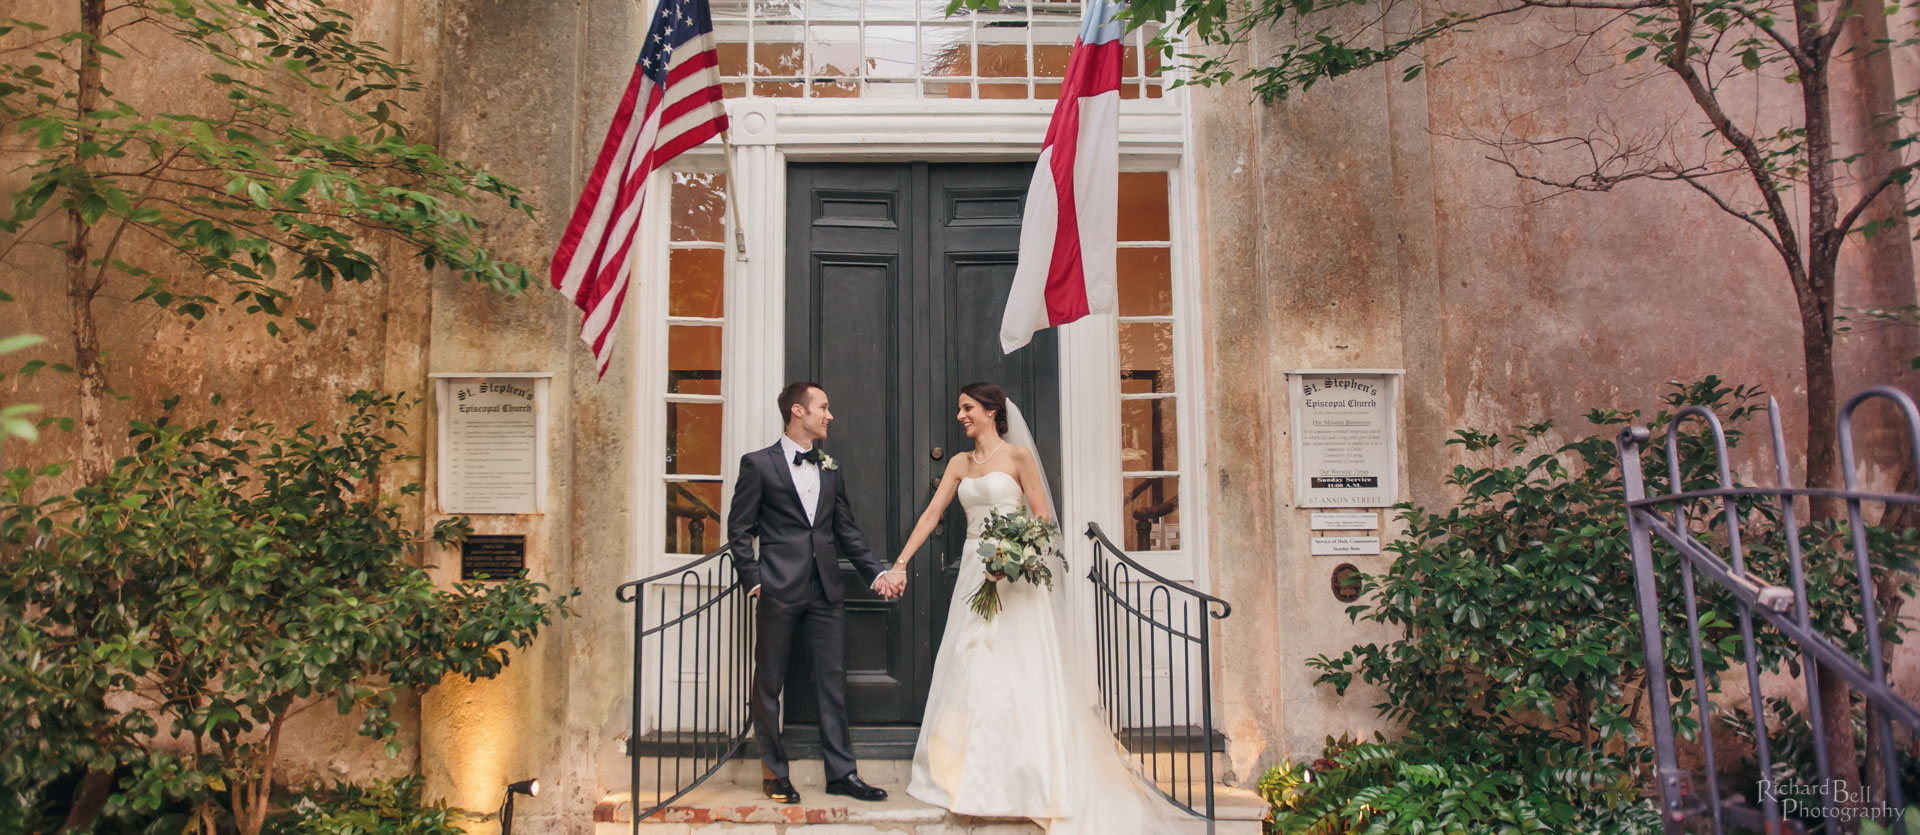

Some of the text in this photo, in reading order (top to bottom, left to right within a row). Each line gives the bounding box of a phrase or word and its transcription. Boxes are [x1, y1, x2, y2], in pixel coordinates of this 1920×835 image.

[457, 383, 534, 401] St. Stephen's
[1303, 378, 1378, 396] St. Stephen's
[459, 404, 532, 414] Episcopal Church
[1306, 399, 1377, 408] Episcopal Church
